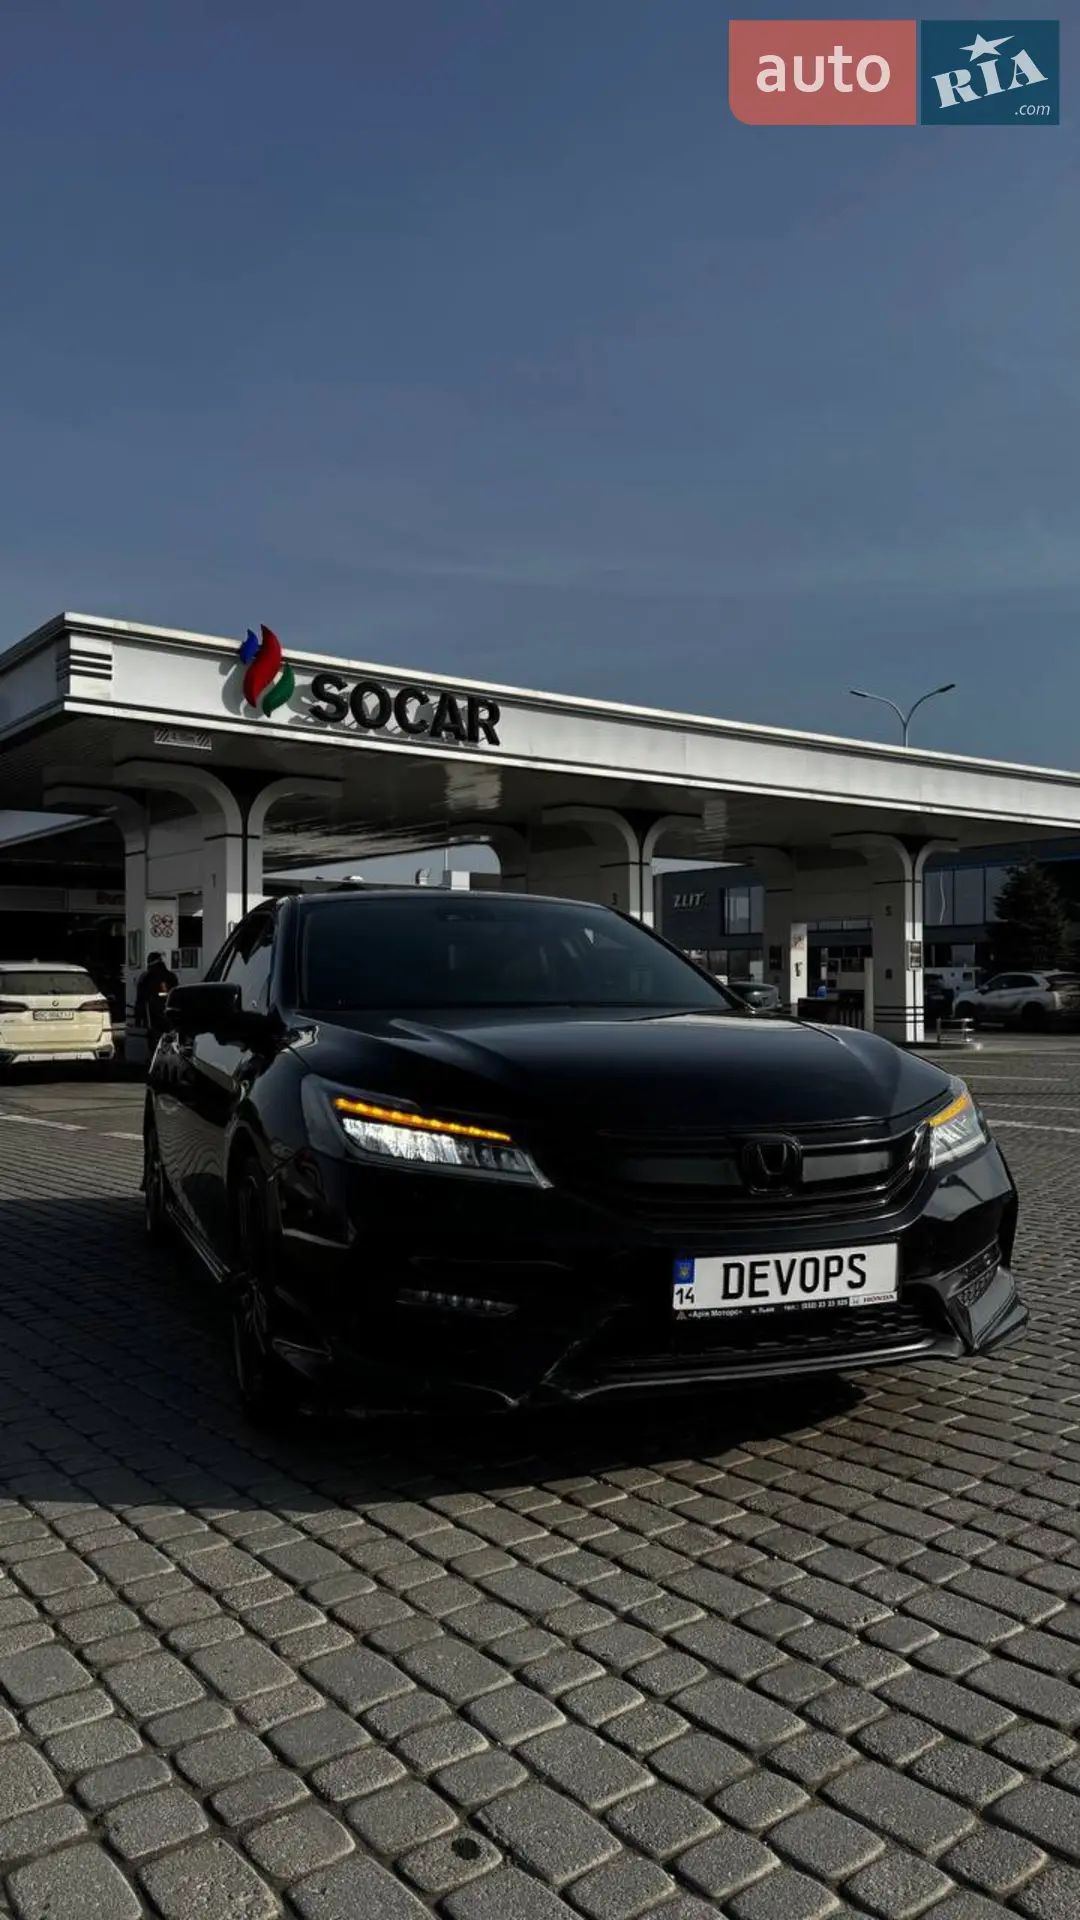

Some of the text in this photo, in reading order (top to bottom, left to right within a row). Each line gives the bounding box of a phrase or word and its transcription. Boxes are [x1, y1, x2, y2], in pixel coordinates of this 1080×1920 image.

[309, 672, 501, 746] SOCAR
[675, 1287, 695, 1305] 14
[721, 1253, 867, 1300] DEVOPS
